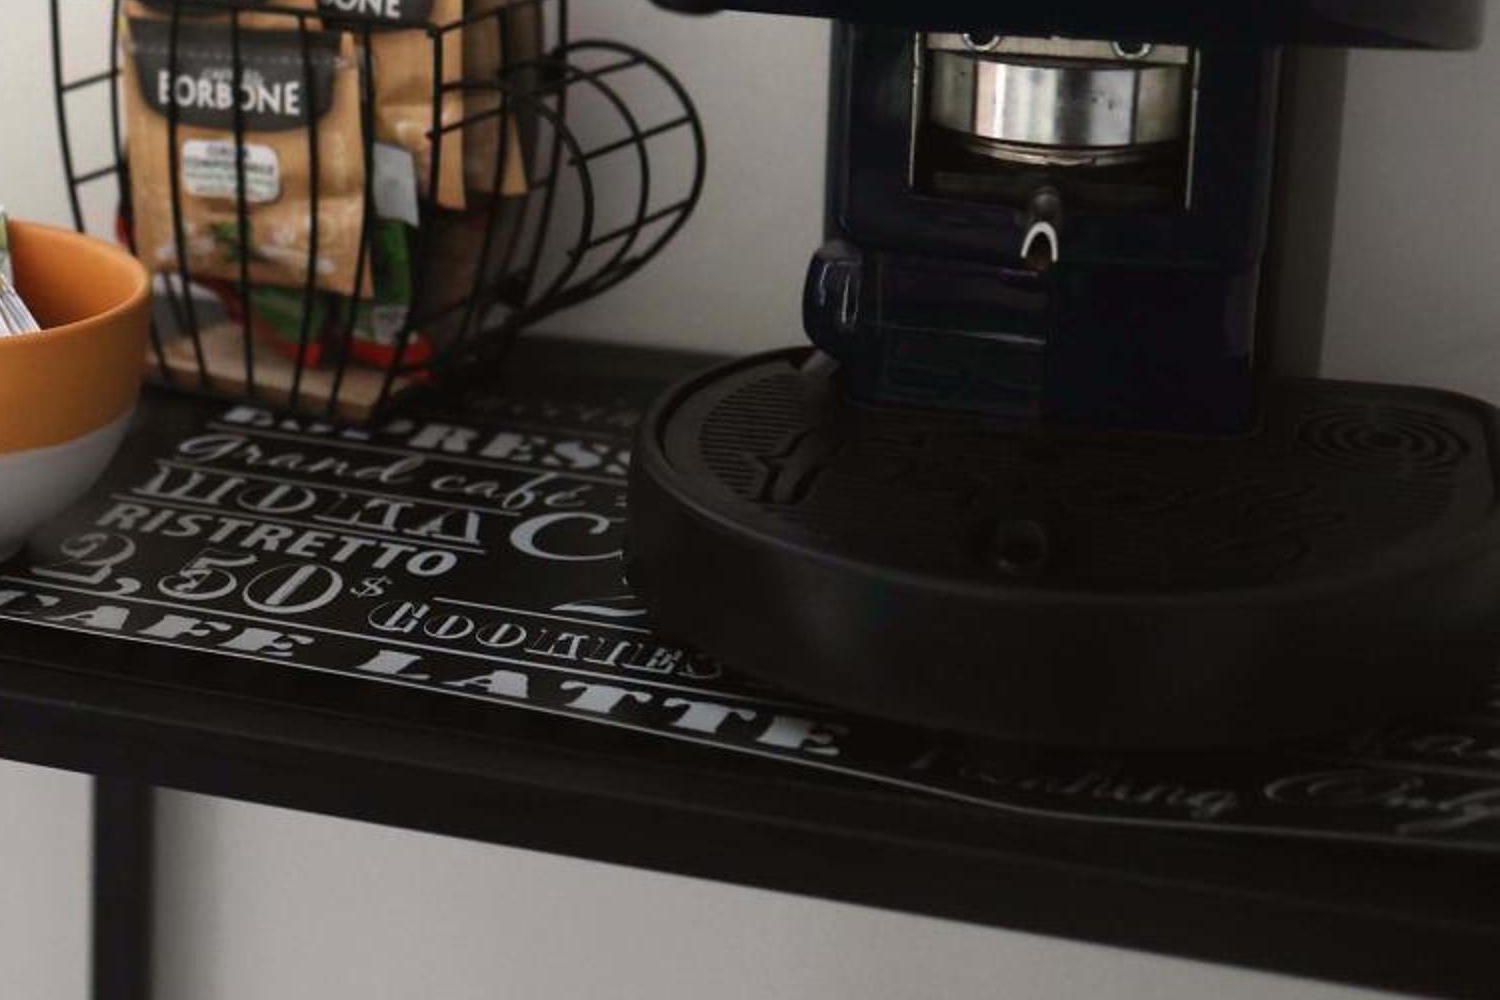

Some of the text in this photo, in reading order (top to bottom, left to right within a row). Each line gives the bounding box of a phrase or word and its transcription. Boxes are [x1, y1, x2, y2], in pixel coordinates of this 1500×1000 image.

[157, 70, 301, 116] BORBONE
[178, 433, 426, 484] Grand
[96, 502, 458, 577] RISTRETTO
[356, 648, 842, 758] LATTE
